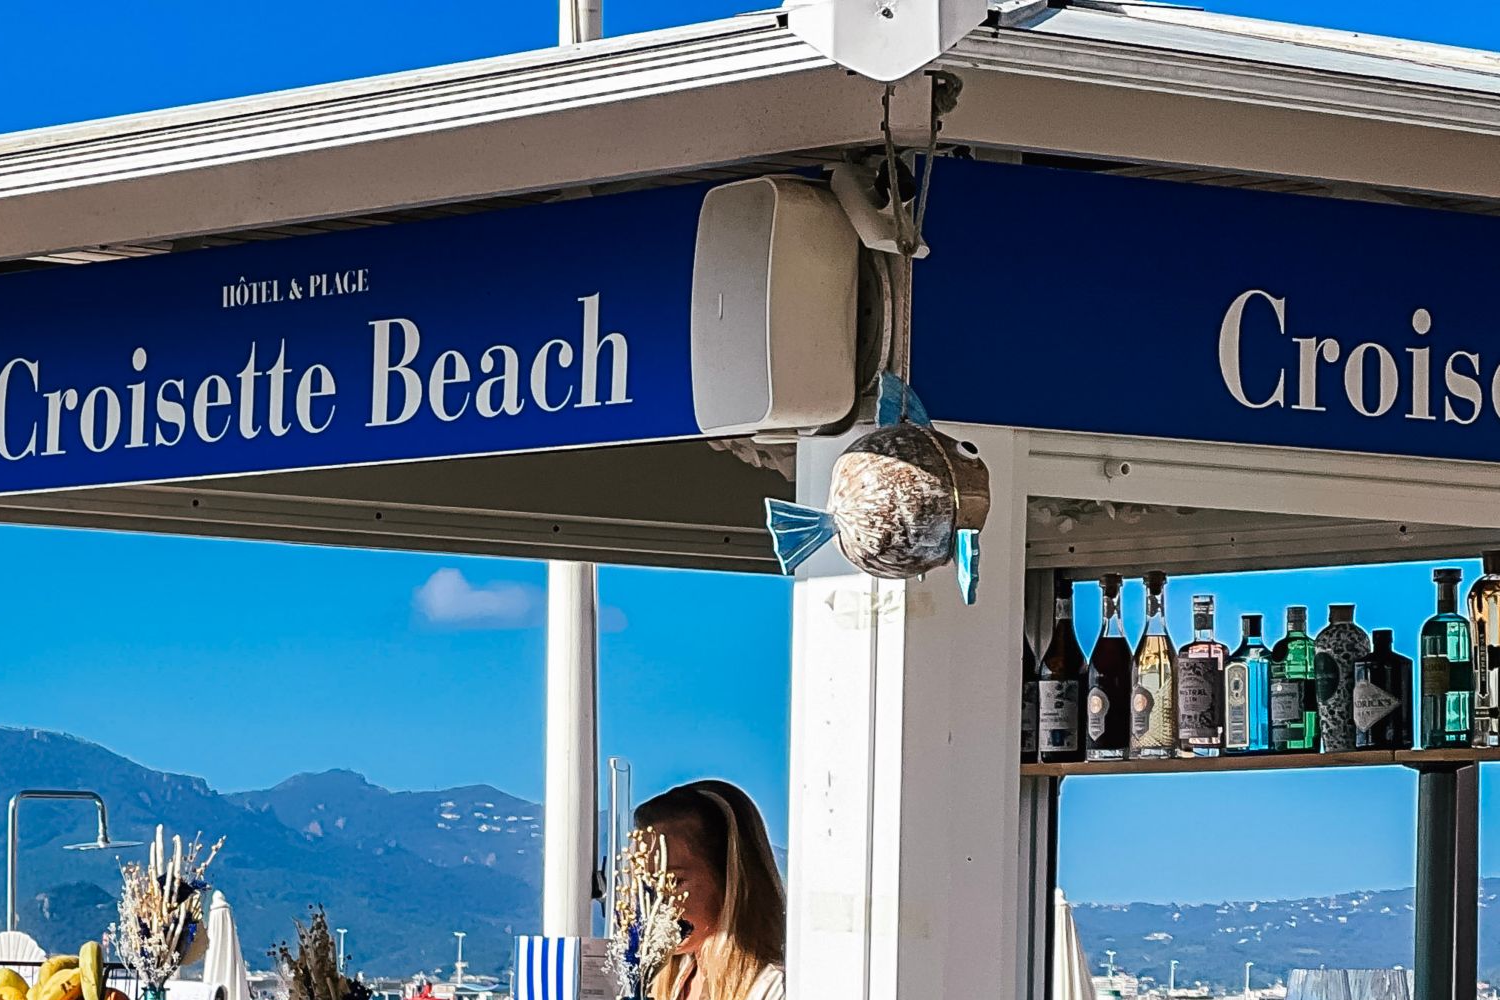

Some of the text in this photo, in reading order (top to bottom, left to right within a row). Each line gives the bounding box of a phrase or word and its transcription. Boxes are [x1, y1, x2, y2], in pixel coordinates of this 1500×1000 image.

[222, 268, 369, 308] HÔTEL & PLAGE
[364, 292, 633, 428] Beach
[1218, 289, 1500, 425] Crois
